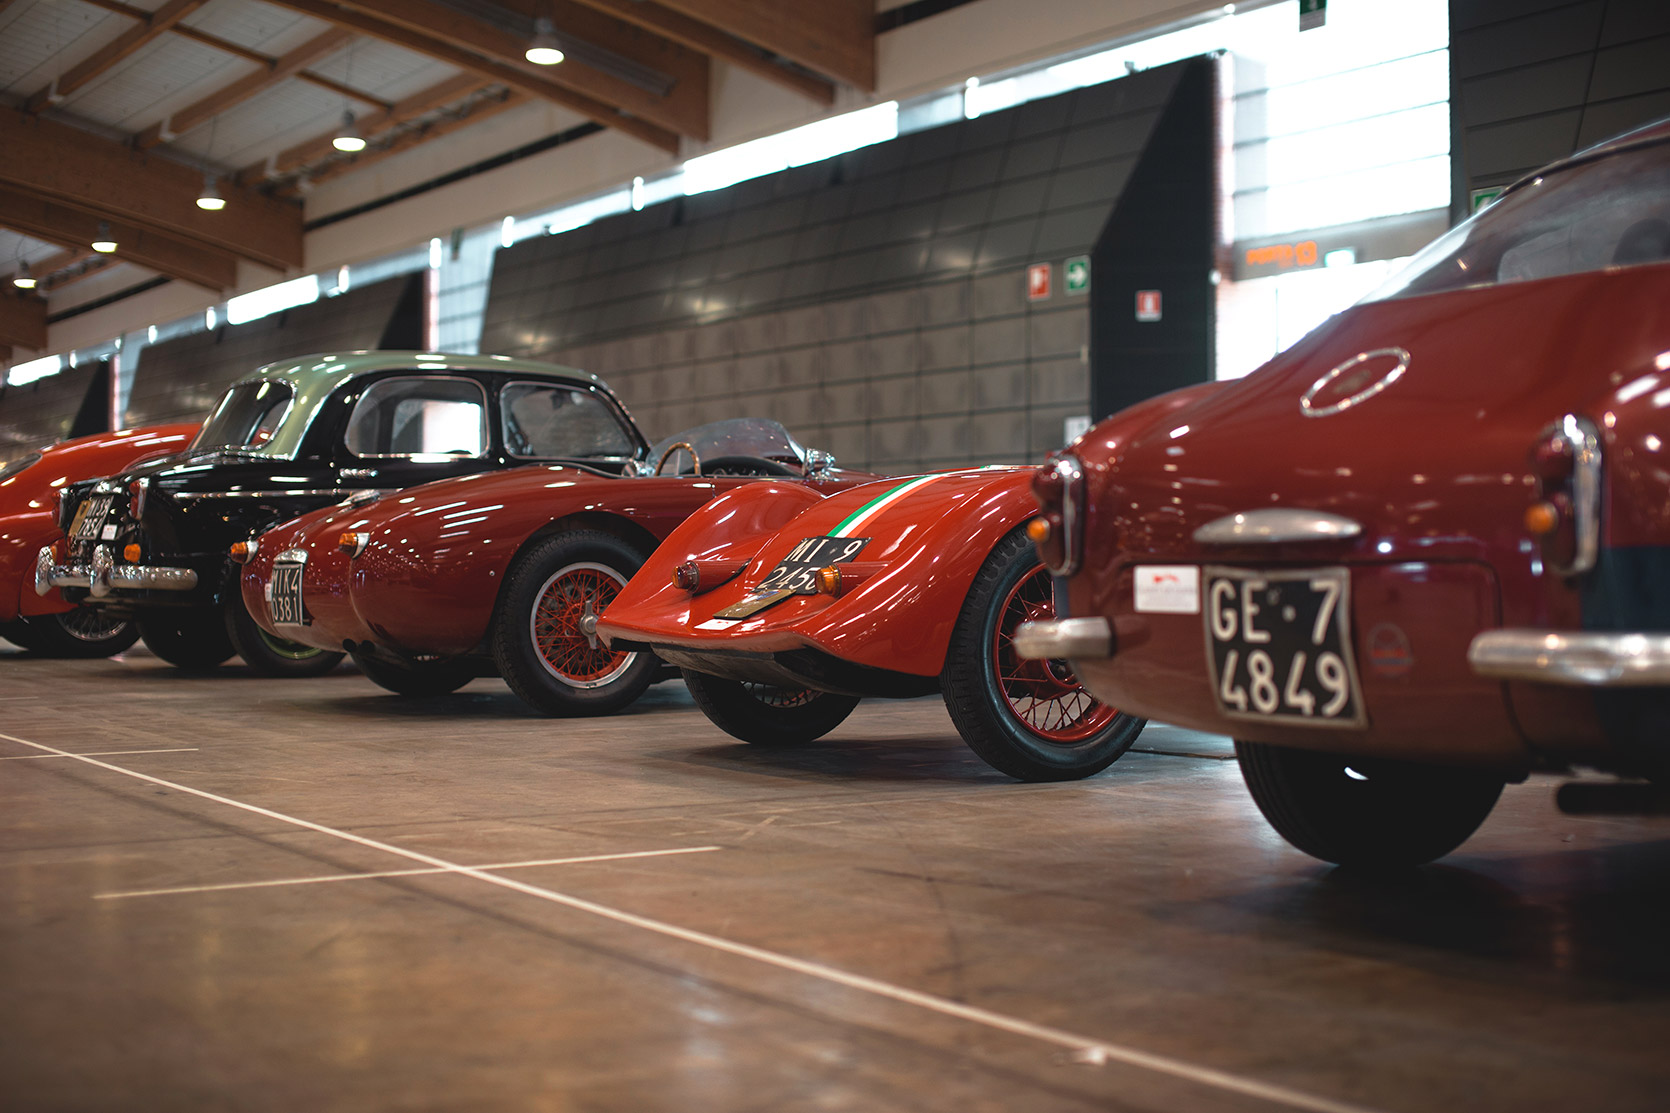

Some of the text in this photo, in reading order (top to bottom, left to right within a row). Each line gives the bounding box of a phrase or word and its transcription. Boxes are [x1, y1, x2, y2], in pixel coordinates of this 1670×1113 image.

[833, 540, 863, 563] 9
[1210, 579, 1341, 645] GE 7
[1220, 649, 1350, 717] 4849
